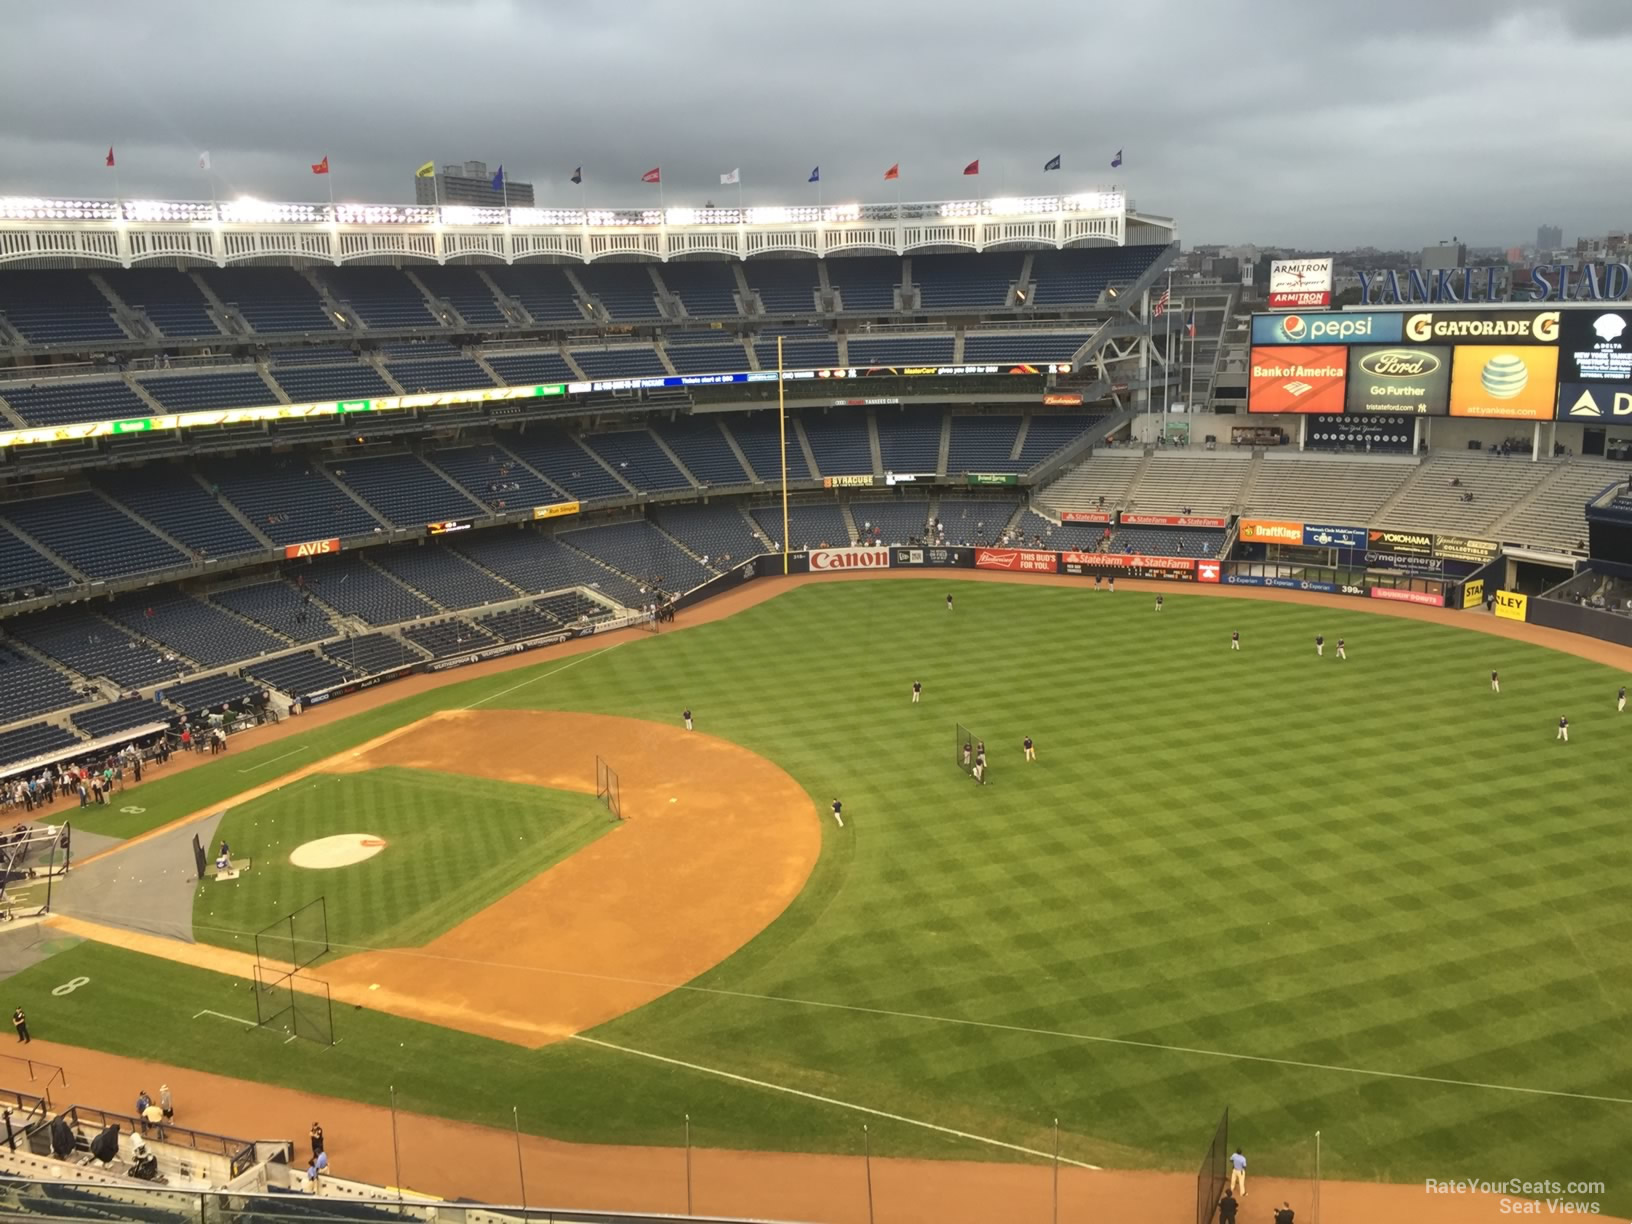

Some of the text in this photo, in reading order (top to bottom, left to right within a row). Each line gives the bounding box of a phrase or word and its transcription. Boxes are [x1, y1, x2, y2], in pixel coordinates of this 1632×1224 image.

[1274, 263, 1328, 273] ARMITRON
[1356, 267, 1506, 304] YANKEE
[1275, 293, 1325, 302] ARMITRON
[1311, 317, 1372, 340] pepsi
[1434, 320, 1530, 336] GATORADE
[1374, 353, 1424, 374] Ford
[1253, 366, 1344, 377] Bank of America
[1370, 386, 1425, 396] Go Further
[1366, 403, 1414, 411] tristateford.com
[1467, 406, 1536, 416] att.yankees.com
[832, 475, 873, 484] SYRACUSE
[1256, 525, 1301, 539] DraftKings
[1383, 533, 1431, 545] YOKOHAMA
[297, 541, 330, 557] AVIS
[1443, 545, 1488, 555] COLLECTIBLES
[811, 551, 888, 570] Canon
[1020, 553, 1056, 562] THIS BUD'S
[1020, 561, 1033, 569] FOR
[1273, 579, 1294, 587] Experian
[310, 693, 329, 704] GEICO
